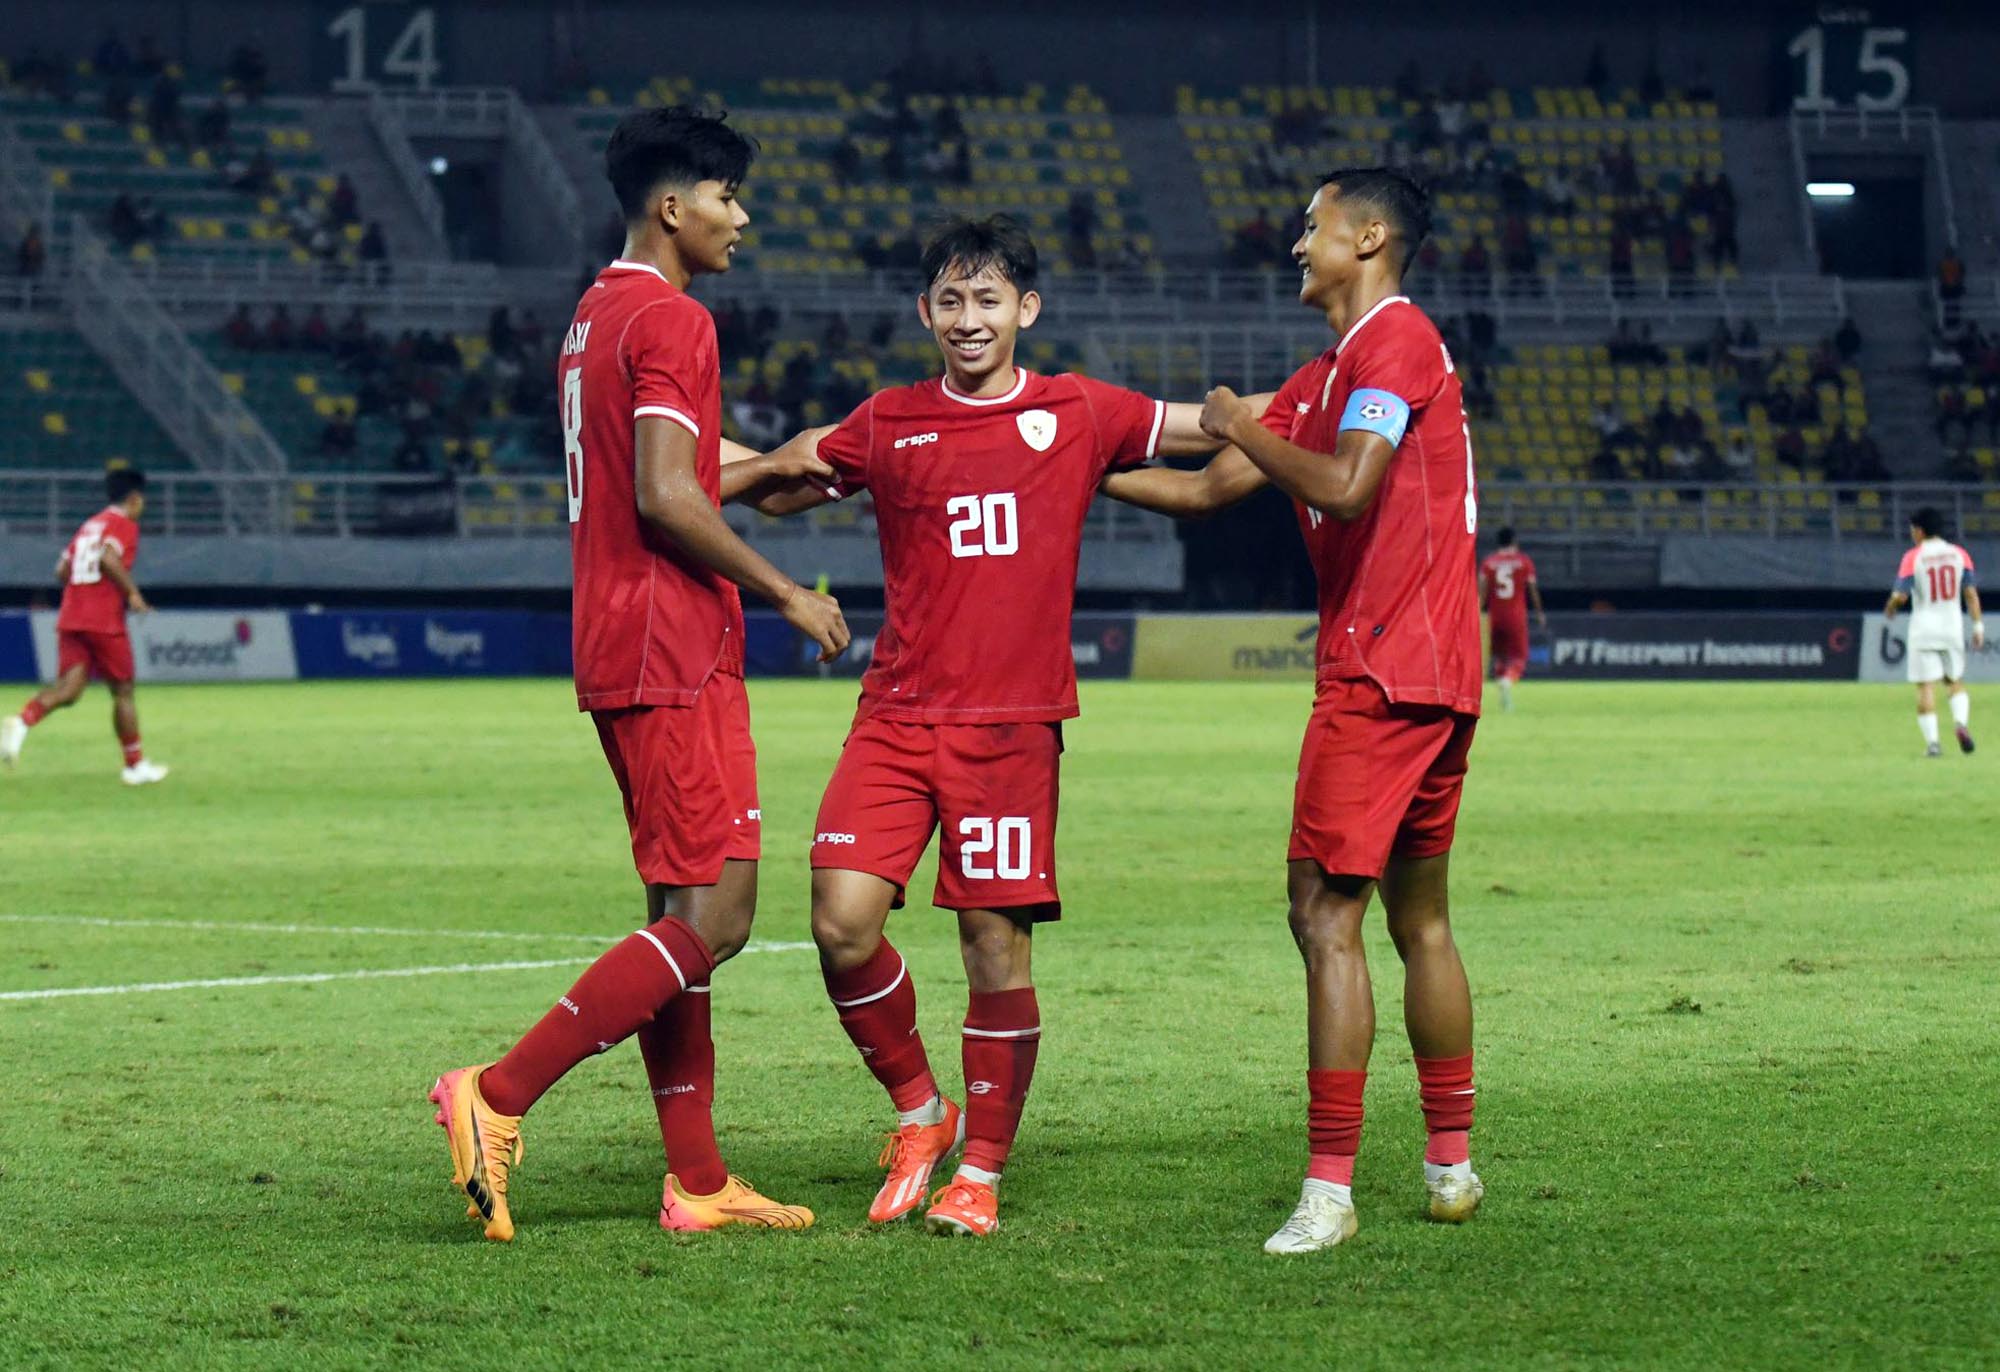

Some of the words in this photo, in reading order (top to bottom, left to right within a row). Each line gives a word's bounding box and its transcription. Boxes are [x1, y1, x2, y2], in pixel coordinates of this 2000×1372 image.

[328, 8, 441, 92] 14
[1787, 26, 1910, 111] 15
[564, 367, 584, 523] 8
[894, 432, 938, 449] erspo
[946, 492, 1018, 558] 20
[1496, 564, 1514, 599] 5
[1927, 565, 1956, 603] 10
[1554, 638, 1588, 666] PT
[1591, 638, 1699, 666] FREEPORT
[1703, 638, 1824, 666] INDONESIA
[817, 832, 855, 845] erspo
[959, 816, 1031, 880] 20
